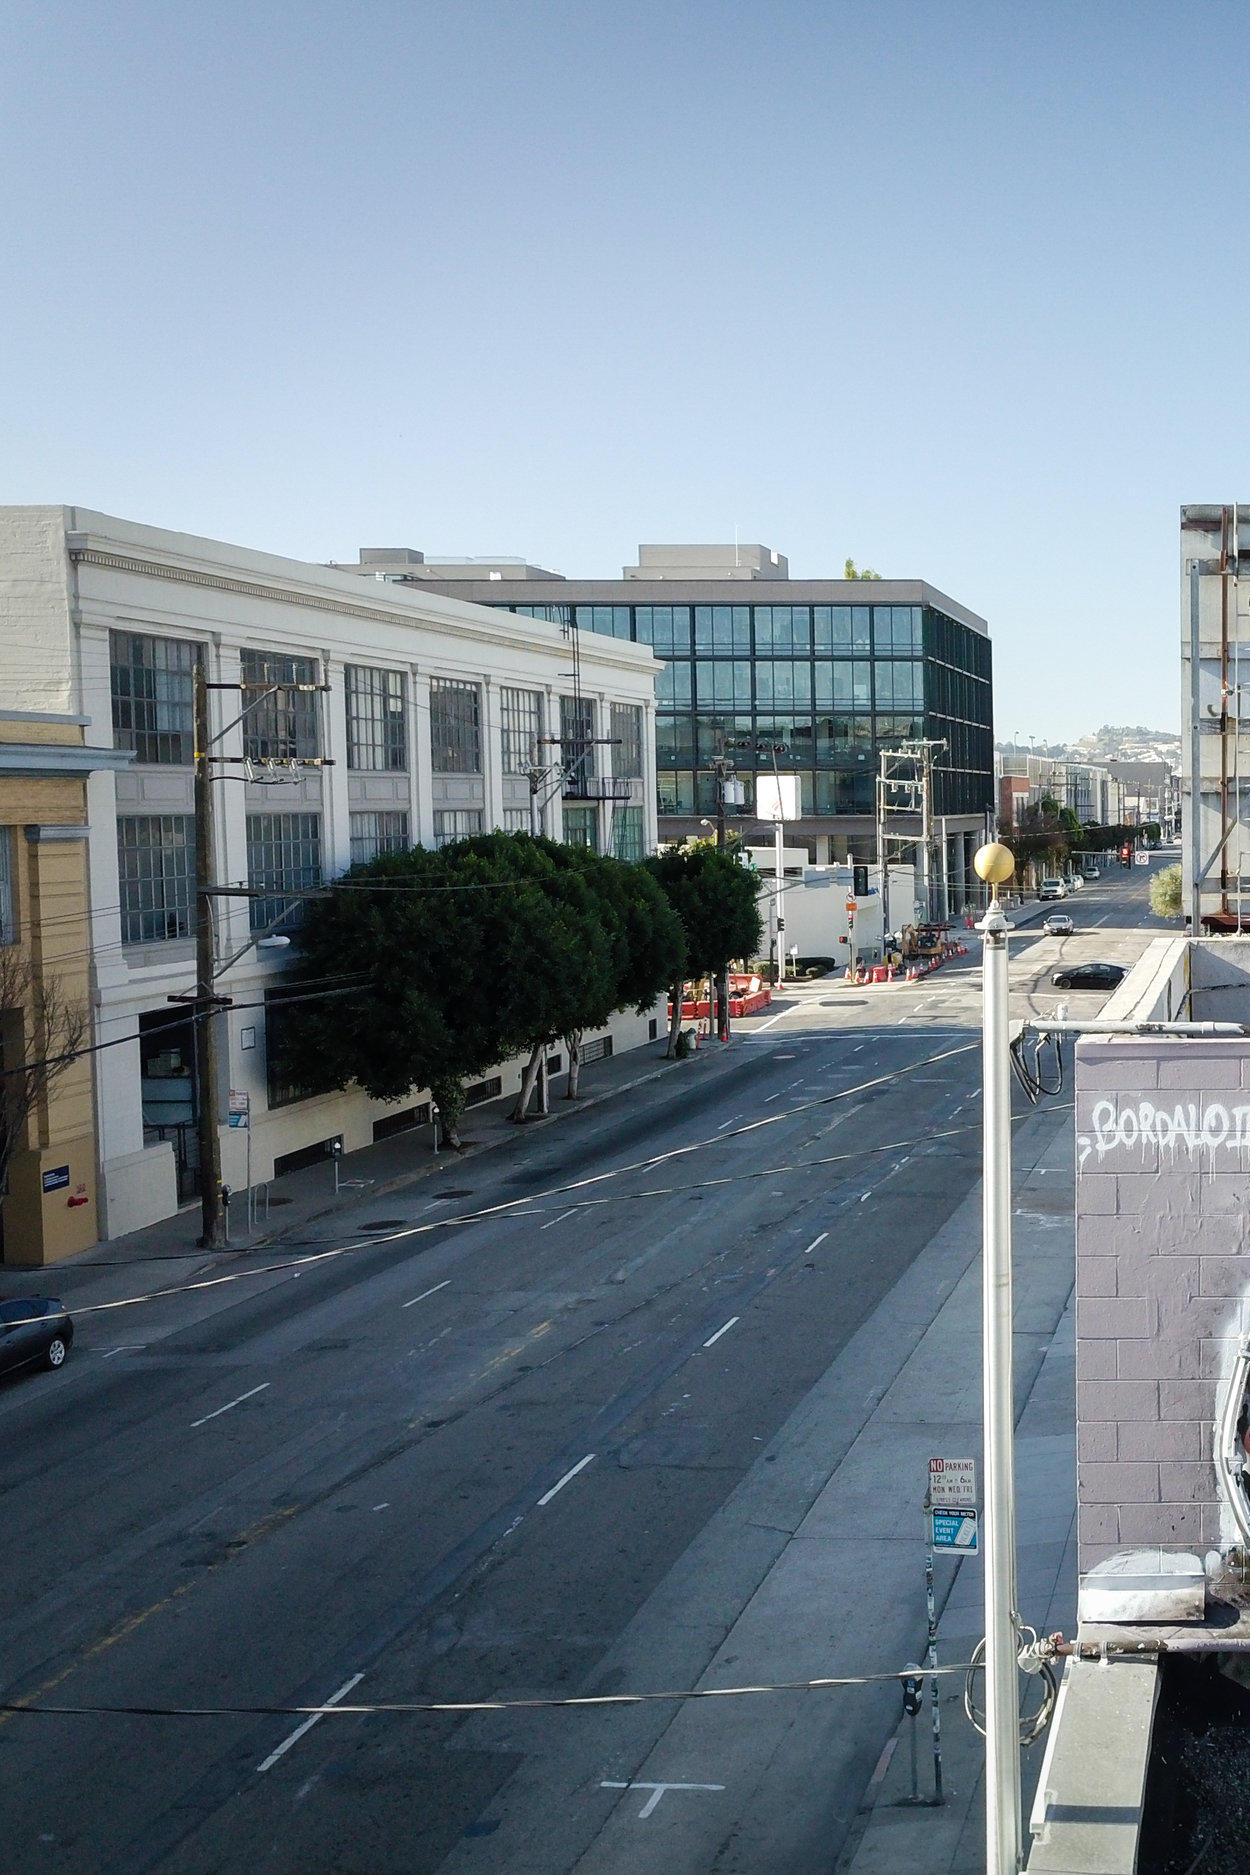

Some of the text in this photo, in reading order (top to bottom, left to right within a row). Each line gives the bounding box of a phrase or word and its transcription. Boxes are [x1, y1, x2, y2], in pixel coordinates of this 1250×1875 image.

[931, 1460, 974, 1471] NO PARKING
[932, 1485, 973, 1493] MON WED FRI
[935, 1519, 959, 1527] SPECIAL
